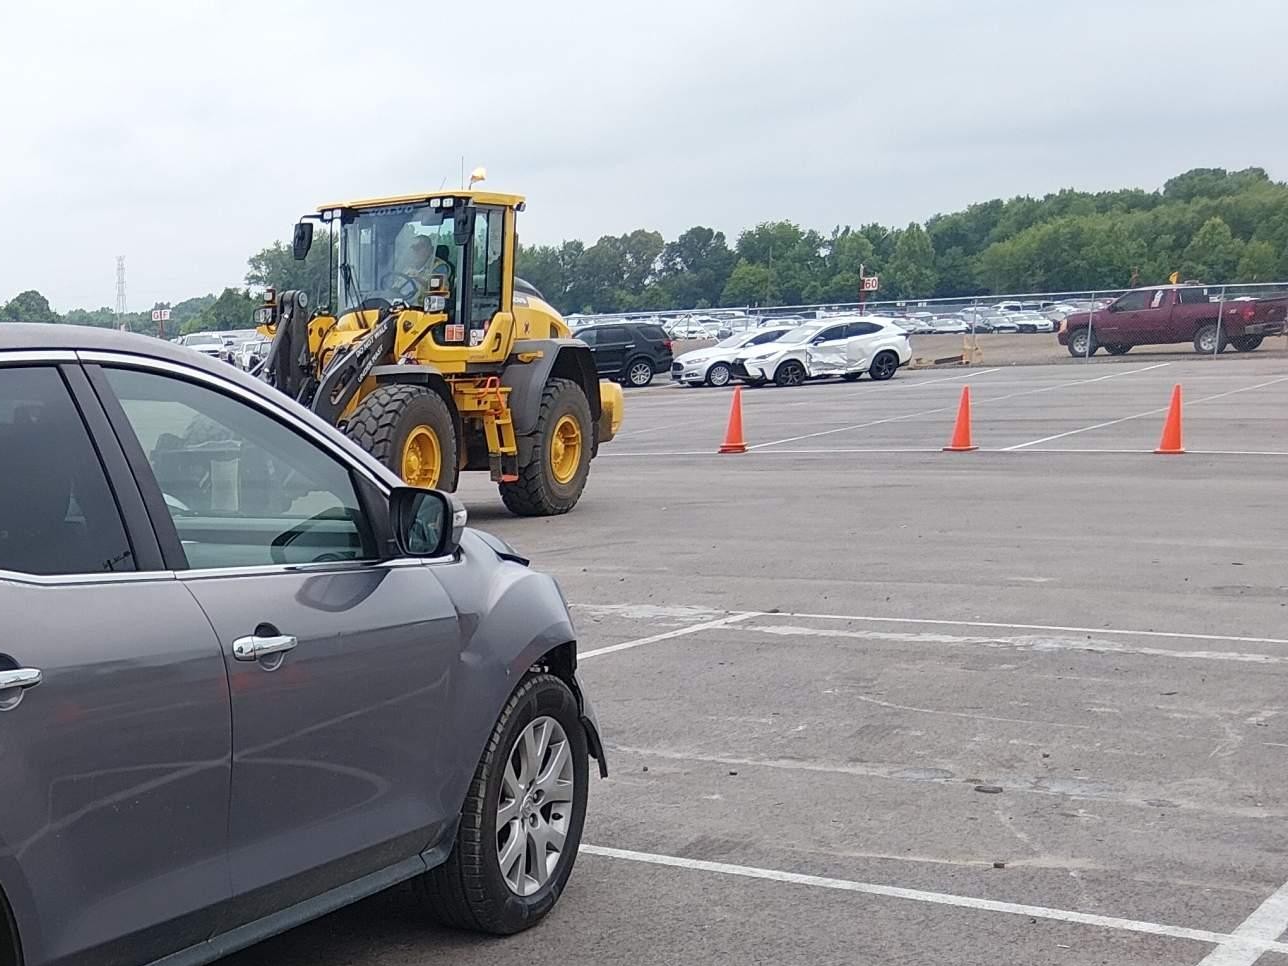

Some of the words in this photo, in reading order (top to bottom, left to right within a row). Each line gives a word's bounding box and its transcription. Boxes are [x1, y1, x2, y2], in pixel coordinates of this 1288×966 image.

[355, 346, 364, 358] DO
[363, 335, 374, 351] NOT
[374, 323, 388, 340] WALK
[357, 360, 373, 383] UNDER
[372, 343, 383, 363] MAST
